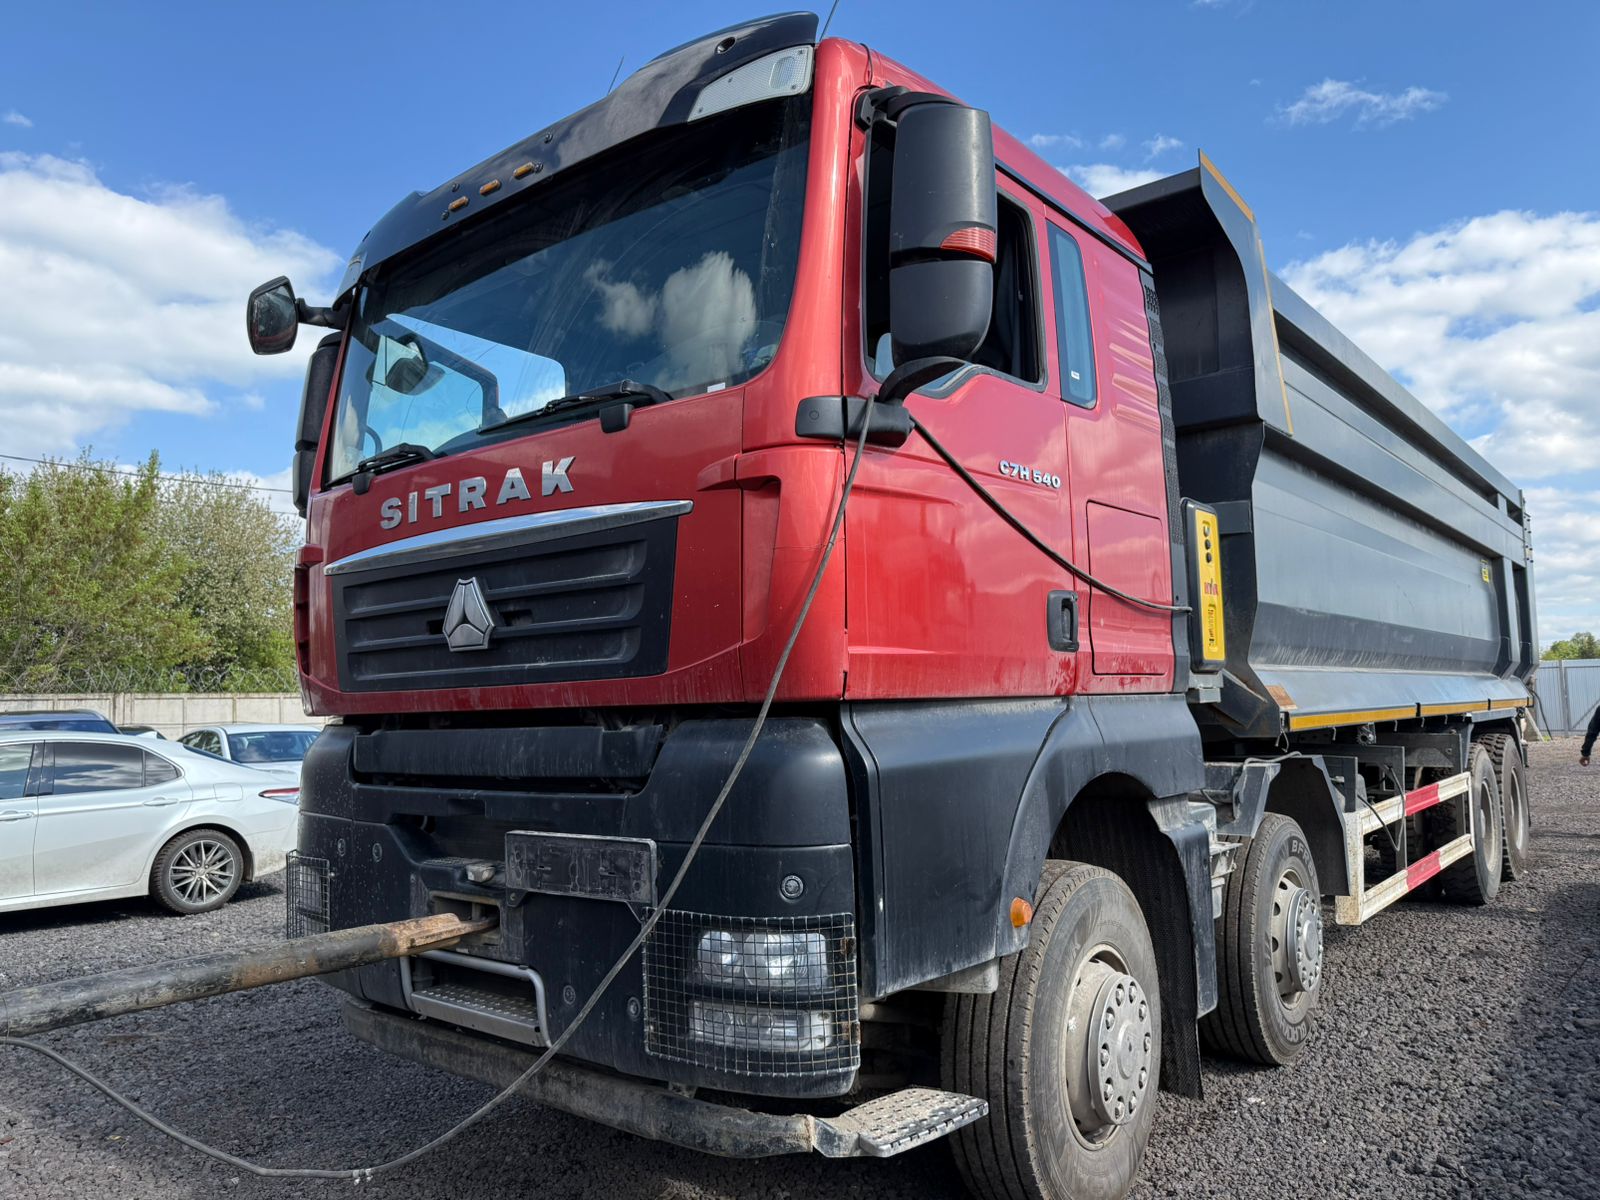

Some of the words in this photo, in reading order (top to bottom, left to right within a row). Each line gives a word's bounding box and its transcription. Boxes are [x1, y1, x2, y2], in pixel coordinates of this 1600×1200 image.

[380, 456, 576, 530] SITRAK
[999, 460, 1030, 480] C7H
[1032, 469, 1061, 488] 540
